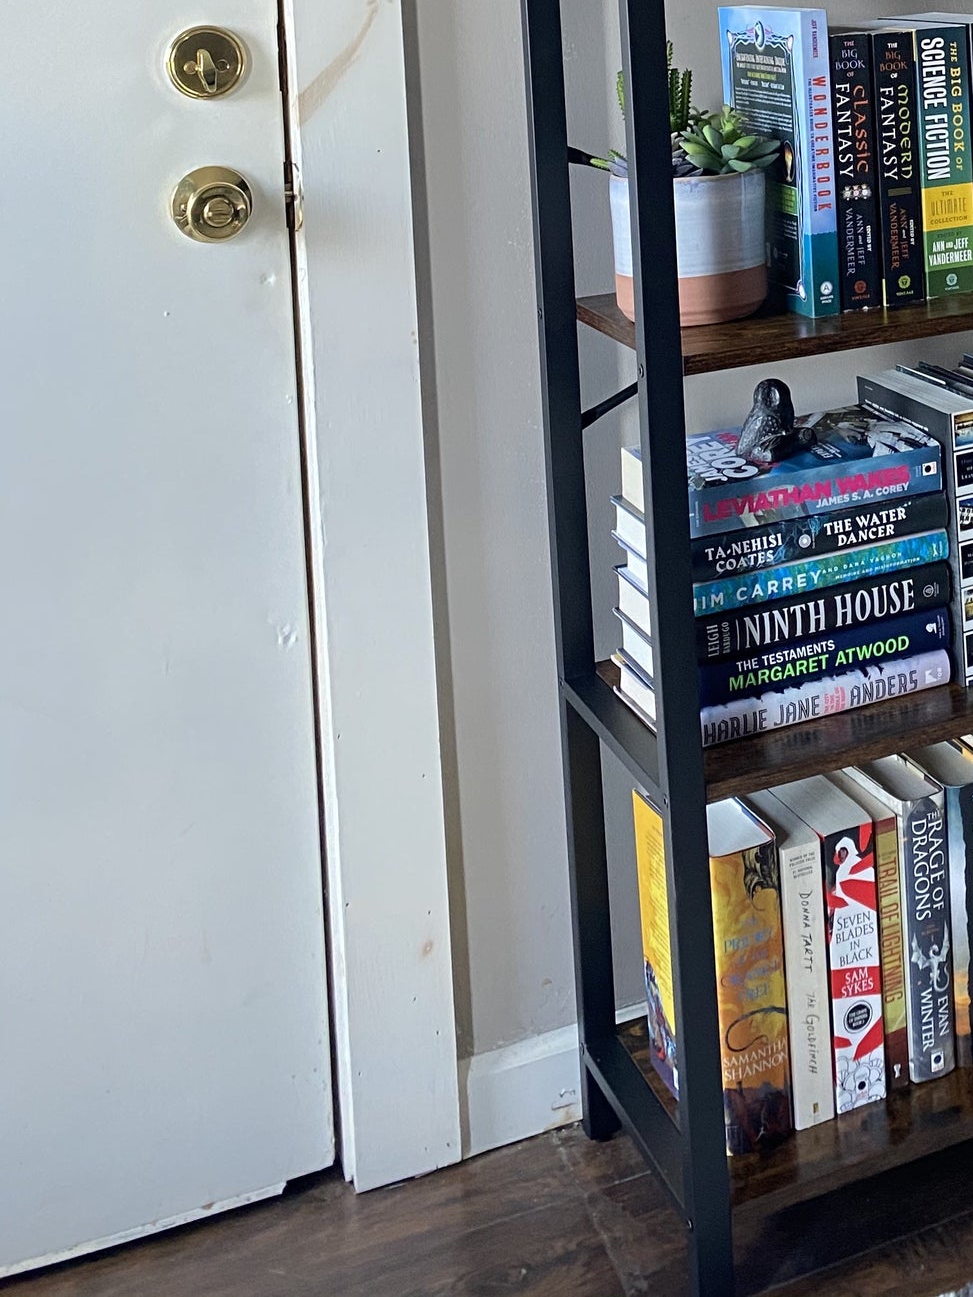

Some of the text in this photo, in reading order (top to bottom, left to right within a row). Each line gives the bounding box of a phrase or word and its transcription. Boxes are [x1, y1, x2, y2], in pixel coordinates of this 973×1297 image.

[835, 83, 853, 178] FANTASY
[880, 87, 898, 180] FANTASY
[920, 37, 951, 180] SCIENCE FICTION
[950, 42, 964, 171] THE BIG BOOK OF
[812, 76, 831, 212] WONDERBOOK
[845, 208, 856, 276] VANDERMEER
[816, 482, 910, 509] JAMES S. A. COREY
[824, 508, 907, 536] THE WATER
[837, 524, 895, 546] DANCER
[708, 624, 719, 657] LEIGH
[744, 579, 915, 649] NINTH HOUSE
[729, 636, 910, 691] MARGARET ATWOOD
[736, 640, 835, 672] THE TESTAMENTS
[773, 670, 919, 726] JANE ANDERS
[911, 819, 930, 921] DRAGONS
[928, 821, 945, 910] RAGE OF
[879, 858, 903, 1003] TRAIL OF LIGHTNING
[841, 978, 874, 998] SYKES
[845, 967, 869, 984] SAM
[920, 988, 934, 1052] WINTER
[938, 995, 949, 1036] EVAN
